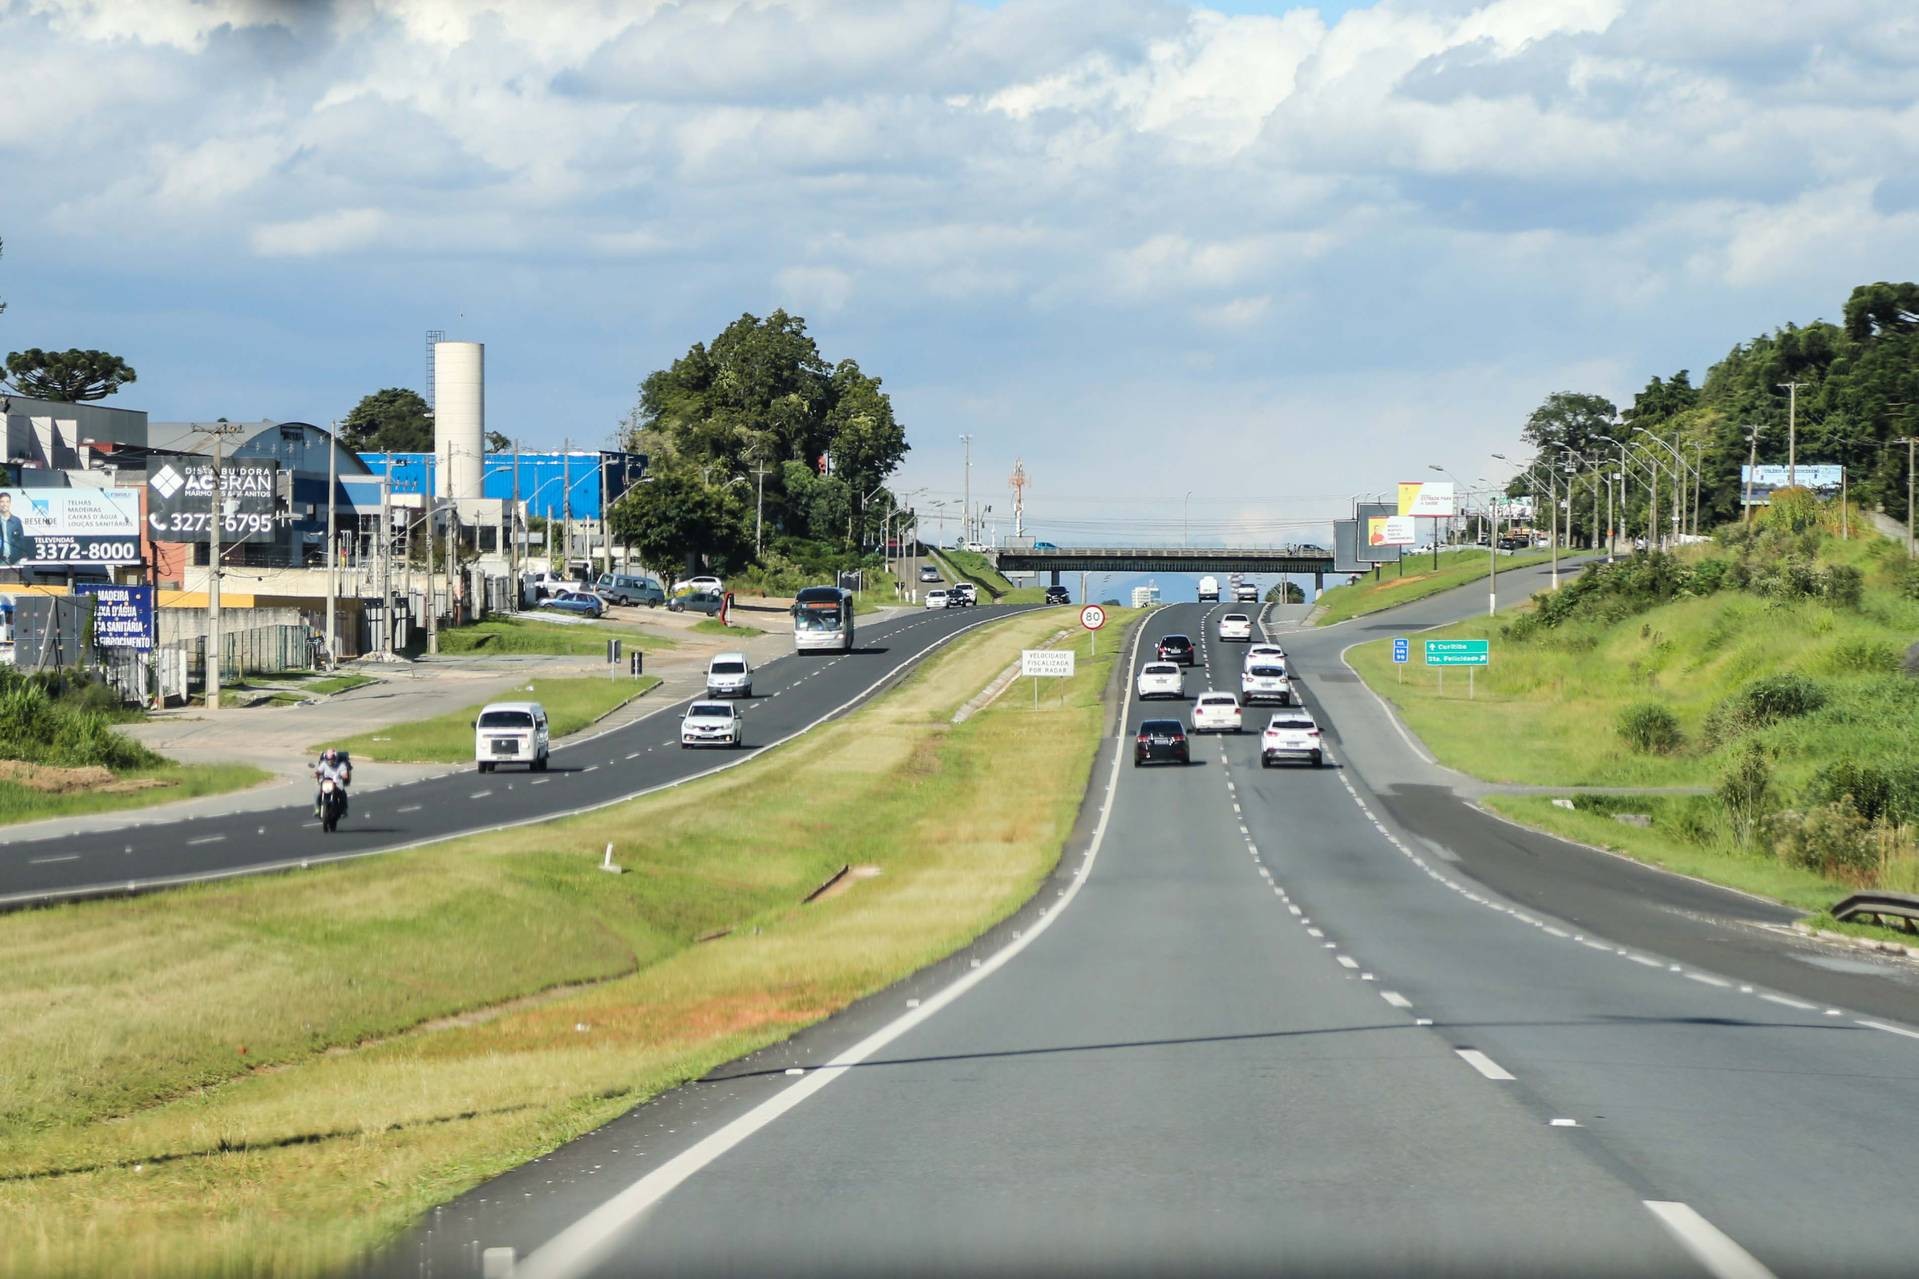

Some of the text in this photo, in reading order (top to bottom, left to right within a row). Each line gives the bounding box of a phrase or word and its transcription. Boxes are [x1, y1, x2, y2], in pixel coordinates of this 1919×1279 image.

[185, 489, 226, 497] MÁRMOS
[24, 517, 57, 525] RESENDE
[35, 543, 135, 560] 3372-8000
[97, 590, 129, 601] MADEIRA
[1086, 612, 1100, 622] 80
